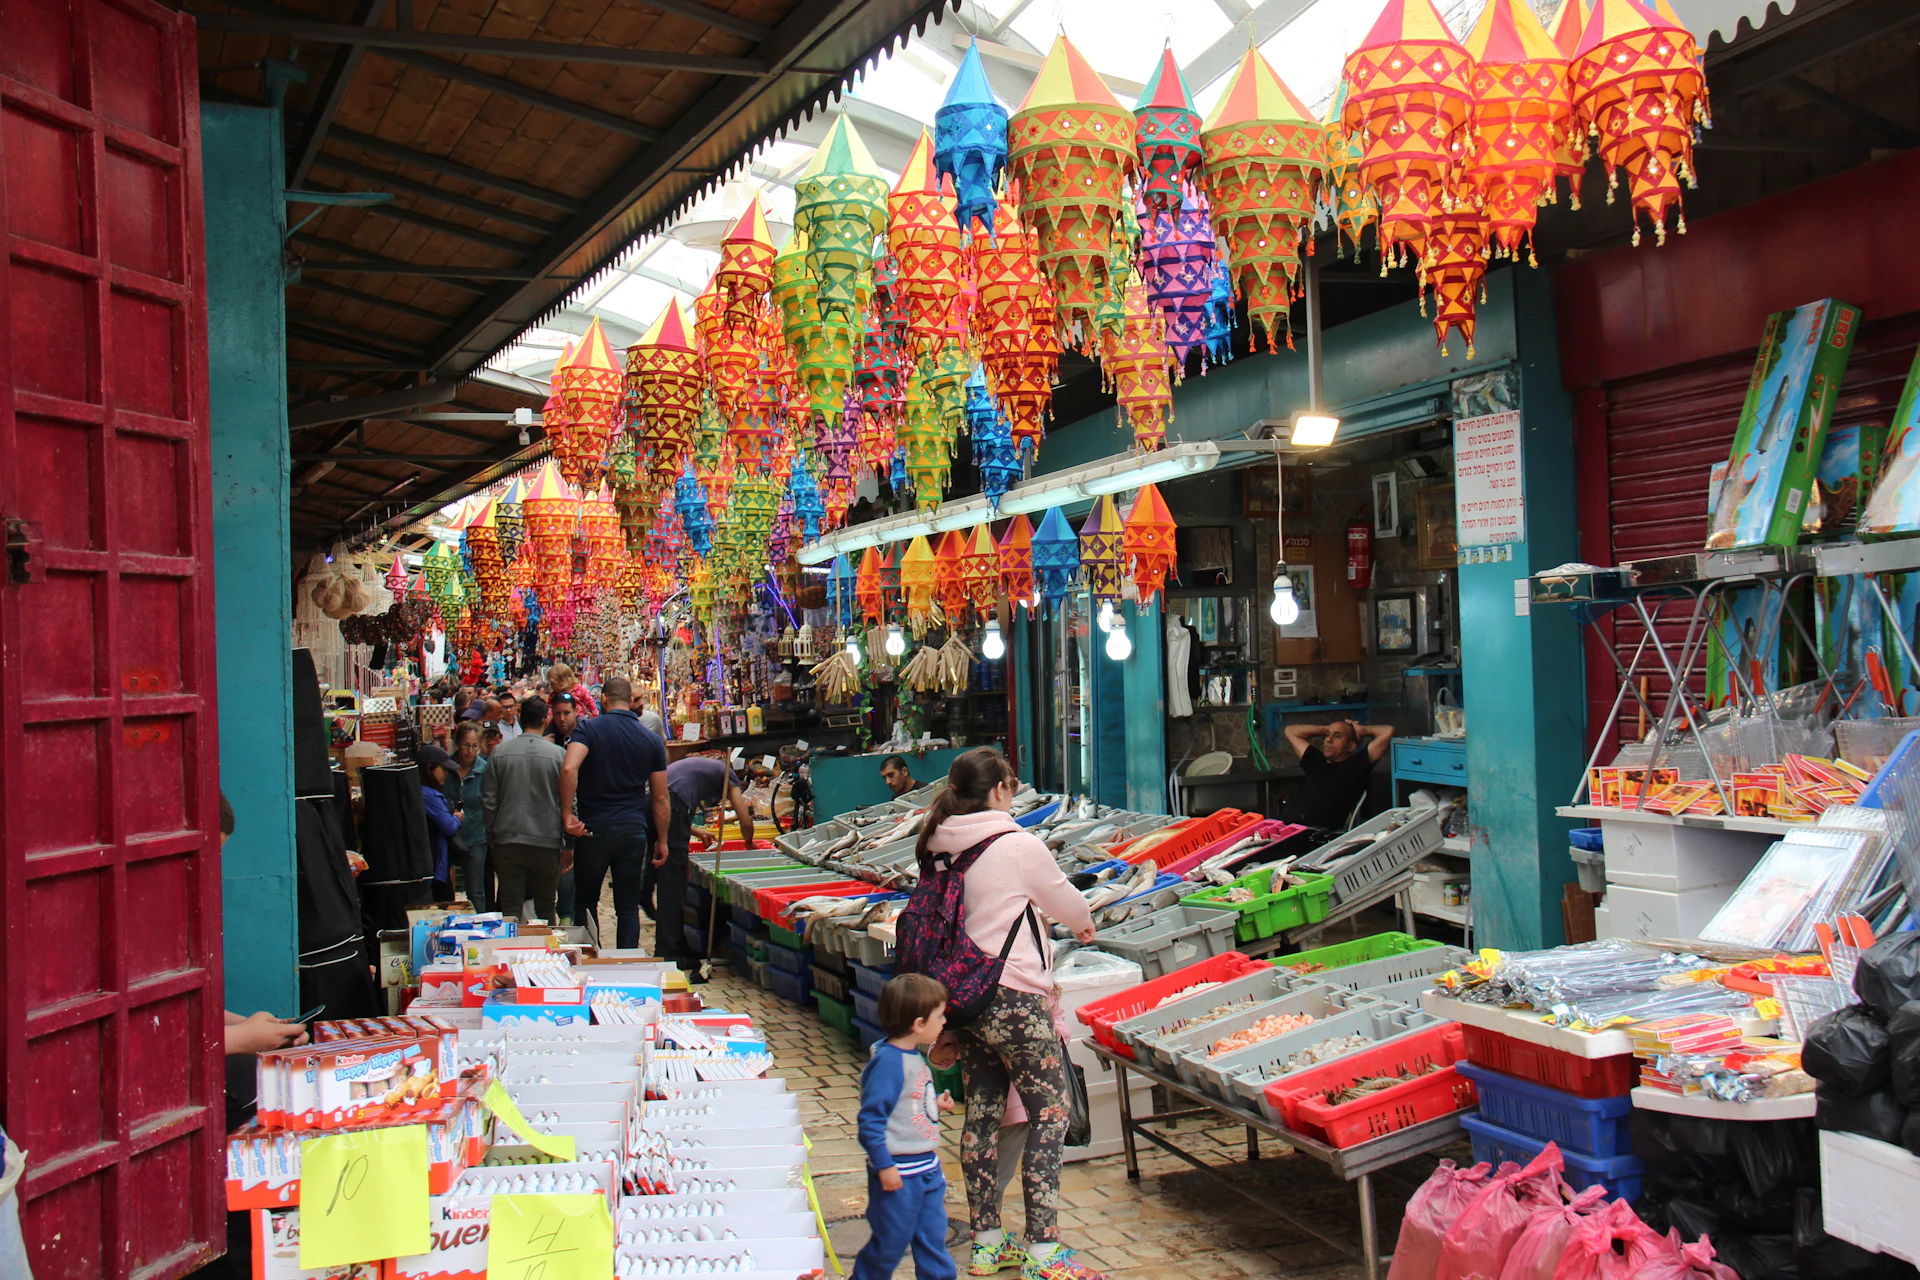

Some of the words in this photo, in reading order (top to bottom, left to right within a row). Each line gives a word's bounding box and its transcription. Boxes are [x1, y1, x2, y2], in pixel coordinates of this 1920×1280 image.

[1806, 305, 1825, 346] BBQ
[1831, 307, 1855, 350] BBQ
[1462, 420, 1475, 431] החיים
[1477, 417, 1490, 428] בדגים
[1491, 414, 1504, 426] לגעת
[1456, 423, 1461, 432] או
[1478, 433, 1491, 444] בטרם
[1492, 429, 1514, 442] המצוננים
[1457, 450, 1473, 461] המצוננים
[1474, 449, 1478, 459] או
[1480, 447, 1490, 458] החיים
[1491, 445, 1502, 456] בדגים
[1473, 464, 1485, 475] עלול
[1504, 459, 1515, 470] לפני
[1458, 466, 1472, 477] לגרום
[1461, 504, 1466, 513] או
[1467, 502, 1477, 512] חיים
[1479, 500, 1489, 511] דגים
[1491, 497, 1505, 510] לקנות
[1507, 498, 1516, 510] ניתן
[1477, 518, 1488, 528] אחרי
[1490, 517, 1496, 528] רק
[1498, 515, 1516, 526] מצוננים
[1291, 538, 1310, 546] סכנה
[335, 1060, 370, 1082] Happy
[369, 1048, 403, 1070] Hippo
[357, 1109, 364, 1119] 5
[326, 1154, 369, 1217] 10
[527, 1213, 566, 1252] 4
[325, 1265, 348, 1277] bueno
